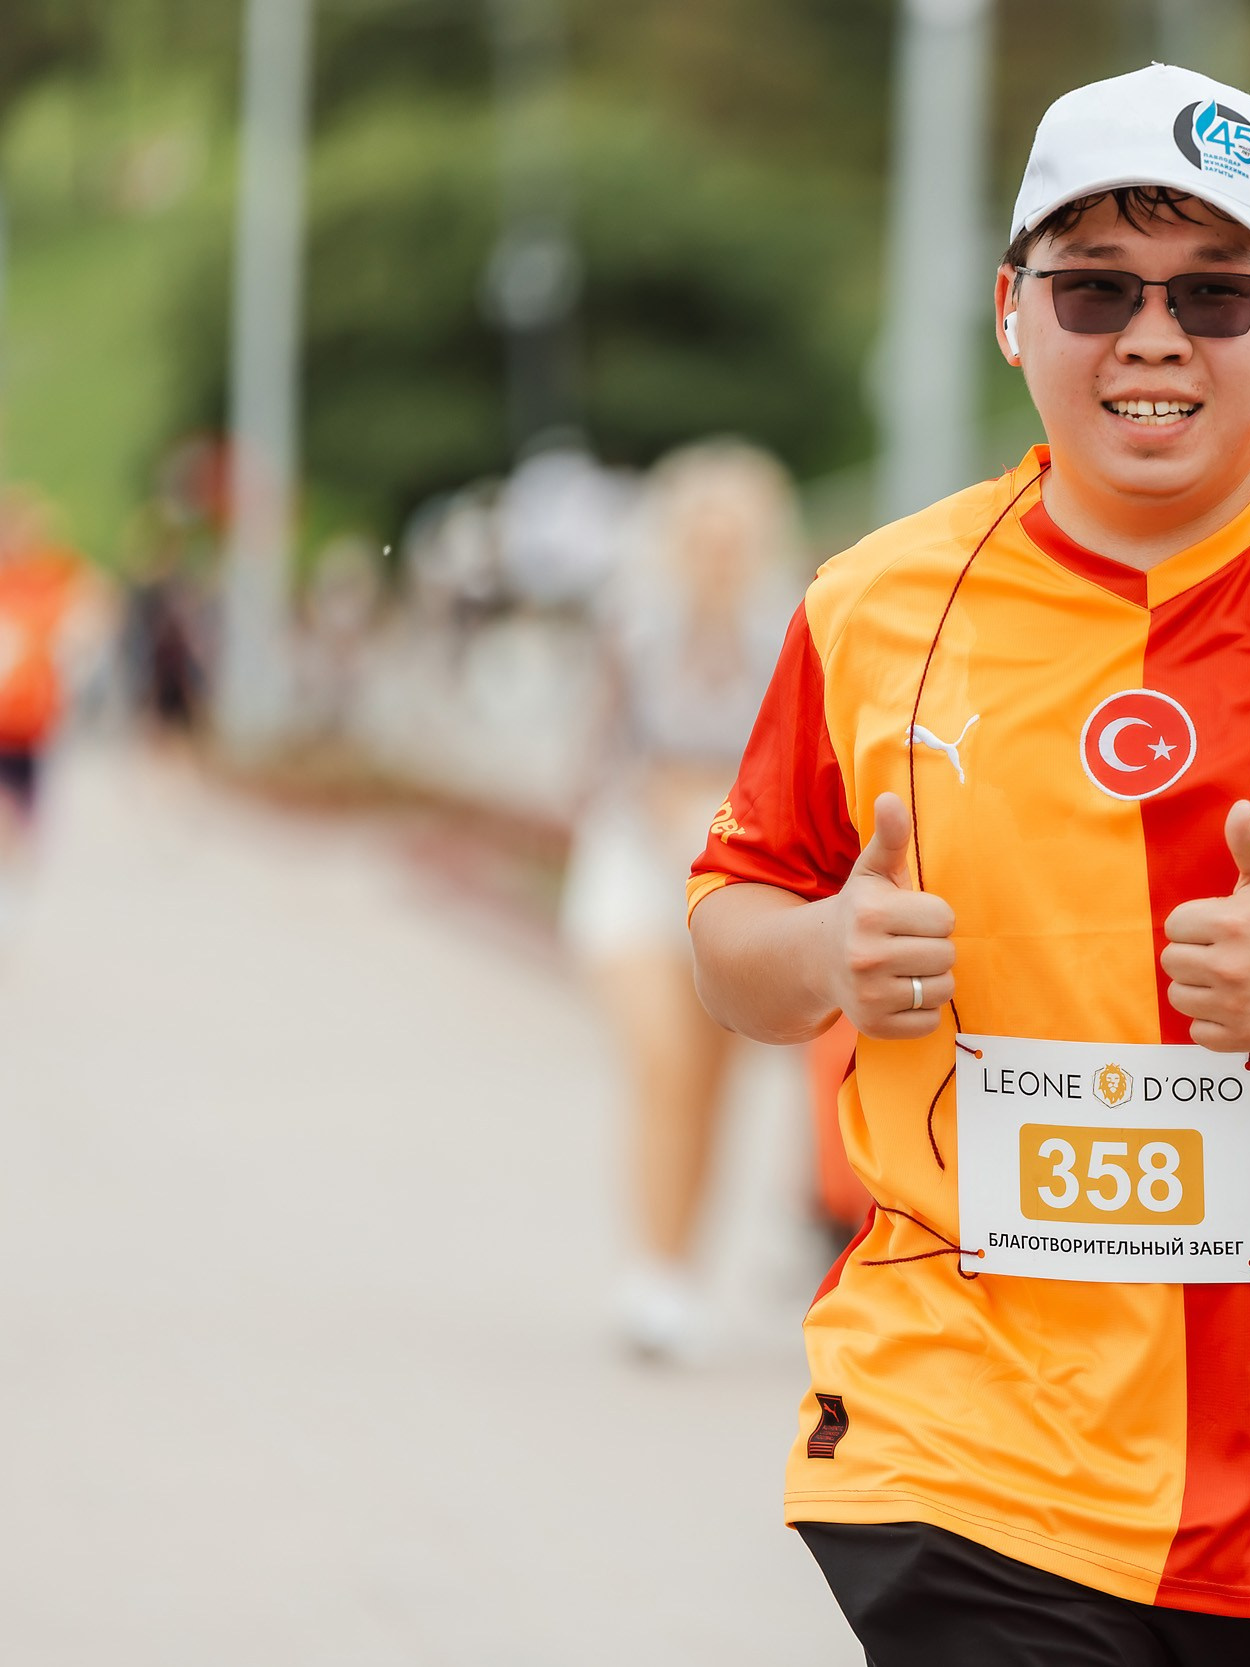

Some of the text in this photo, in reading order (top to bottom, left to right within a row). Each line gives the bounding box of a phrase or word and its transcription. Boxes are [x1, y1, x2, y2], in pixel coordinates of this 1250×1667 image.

[983, 1067, 1243, 1102] LEONE D'ORO
[1037, 1137, 1183, 1213] 358
[988, 1232, 1244, 1256] БЛАГОТВОРИТЕЛЬНЫЙ ЗАБЕГ
